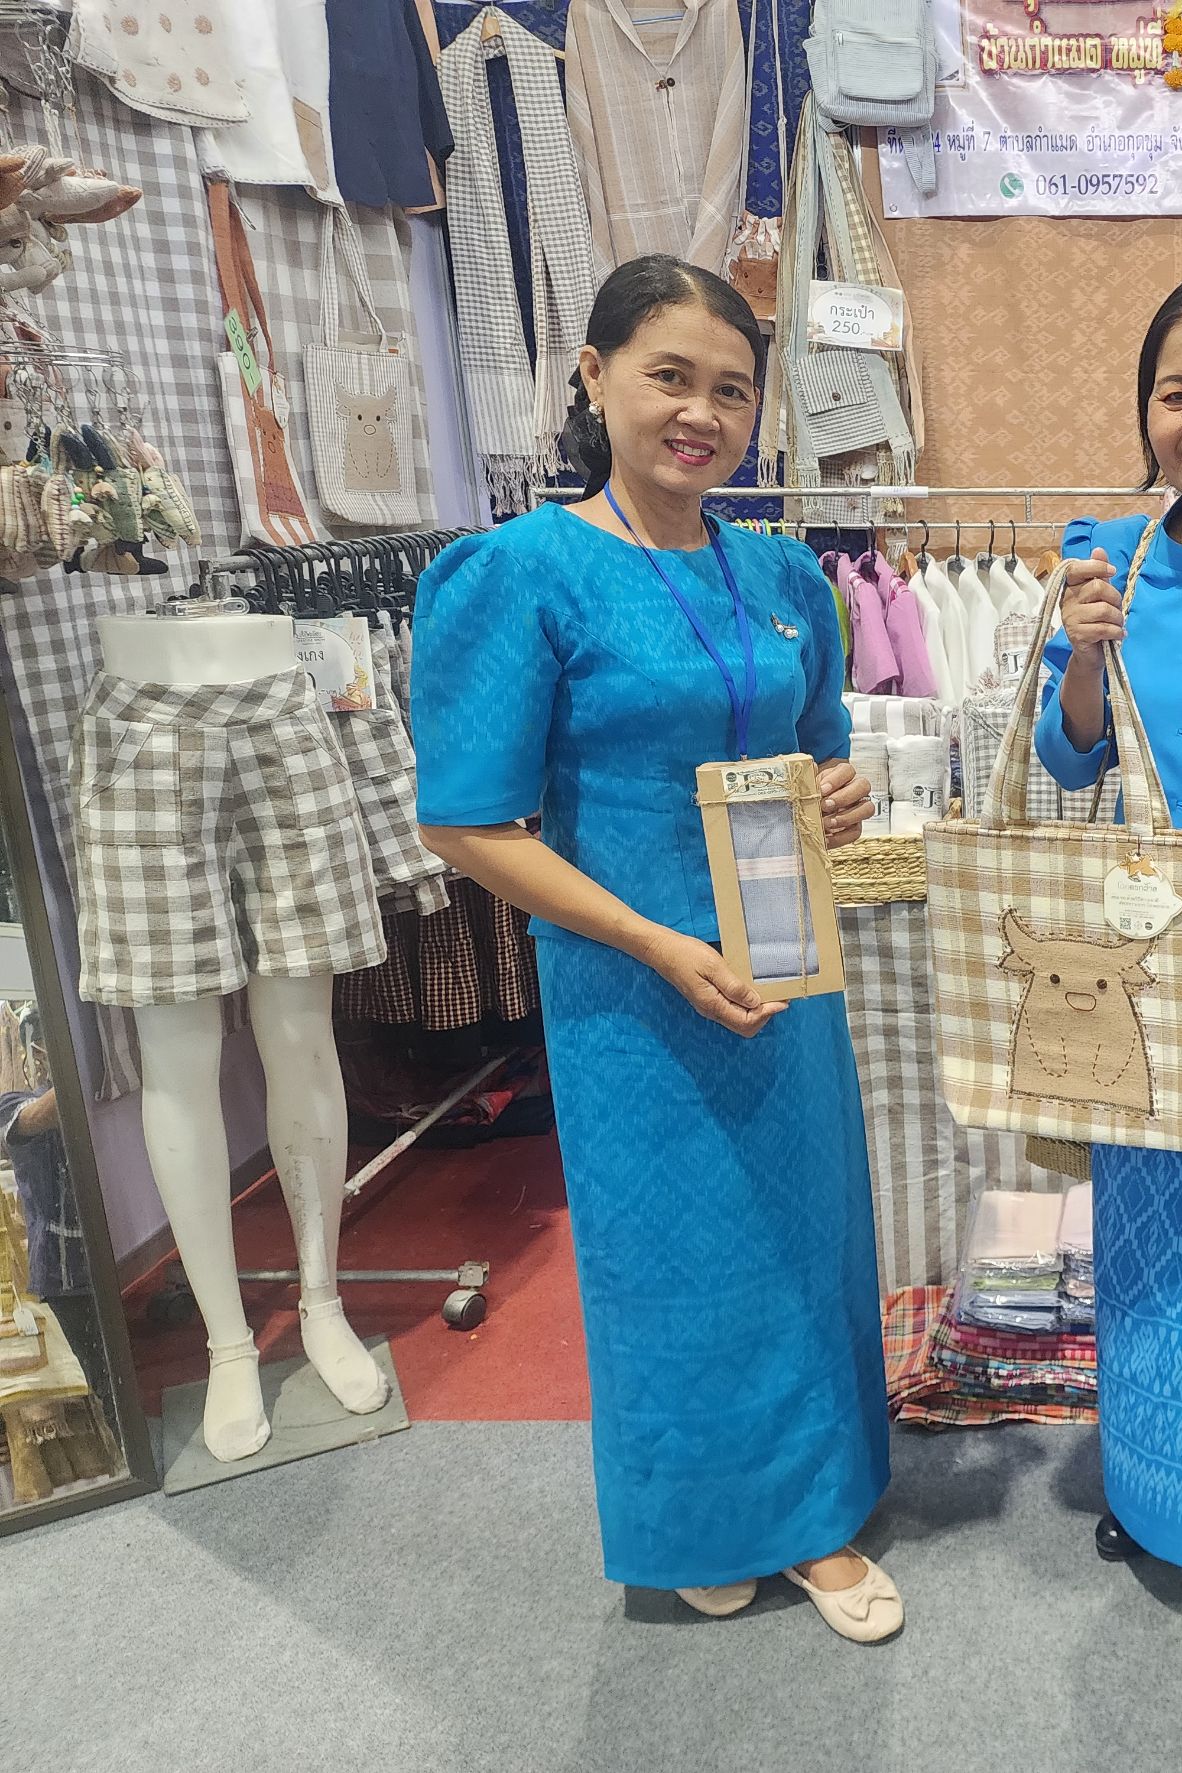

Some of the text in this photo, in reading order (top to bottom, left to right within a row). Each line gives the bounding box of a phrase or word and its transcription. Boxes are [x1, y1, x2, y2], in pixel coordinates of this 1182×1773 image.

[980, 19, 1102, 71] บ้านกำแมด
[947, 121, 976, 162] หมู่ที่
[982, 131, 991, 152] 7
[1000, 126, 1078, 152] ตำบลกำแมด
[1086, 126, 1163, 161] อำเภอกุดชุม
[1036, 173, 1159, 195] 061-0957592
[296, 650, 325, 662] งเกง
